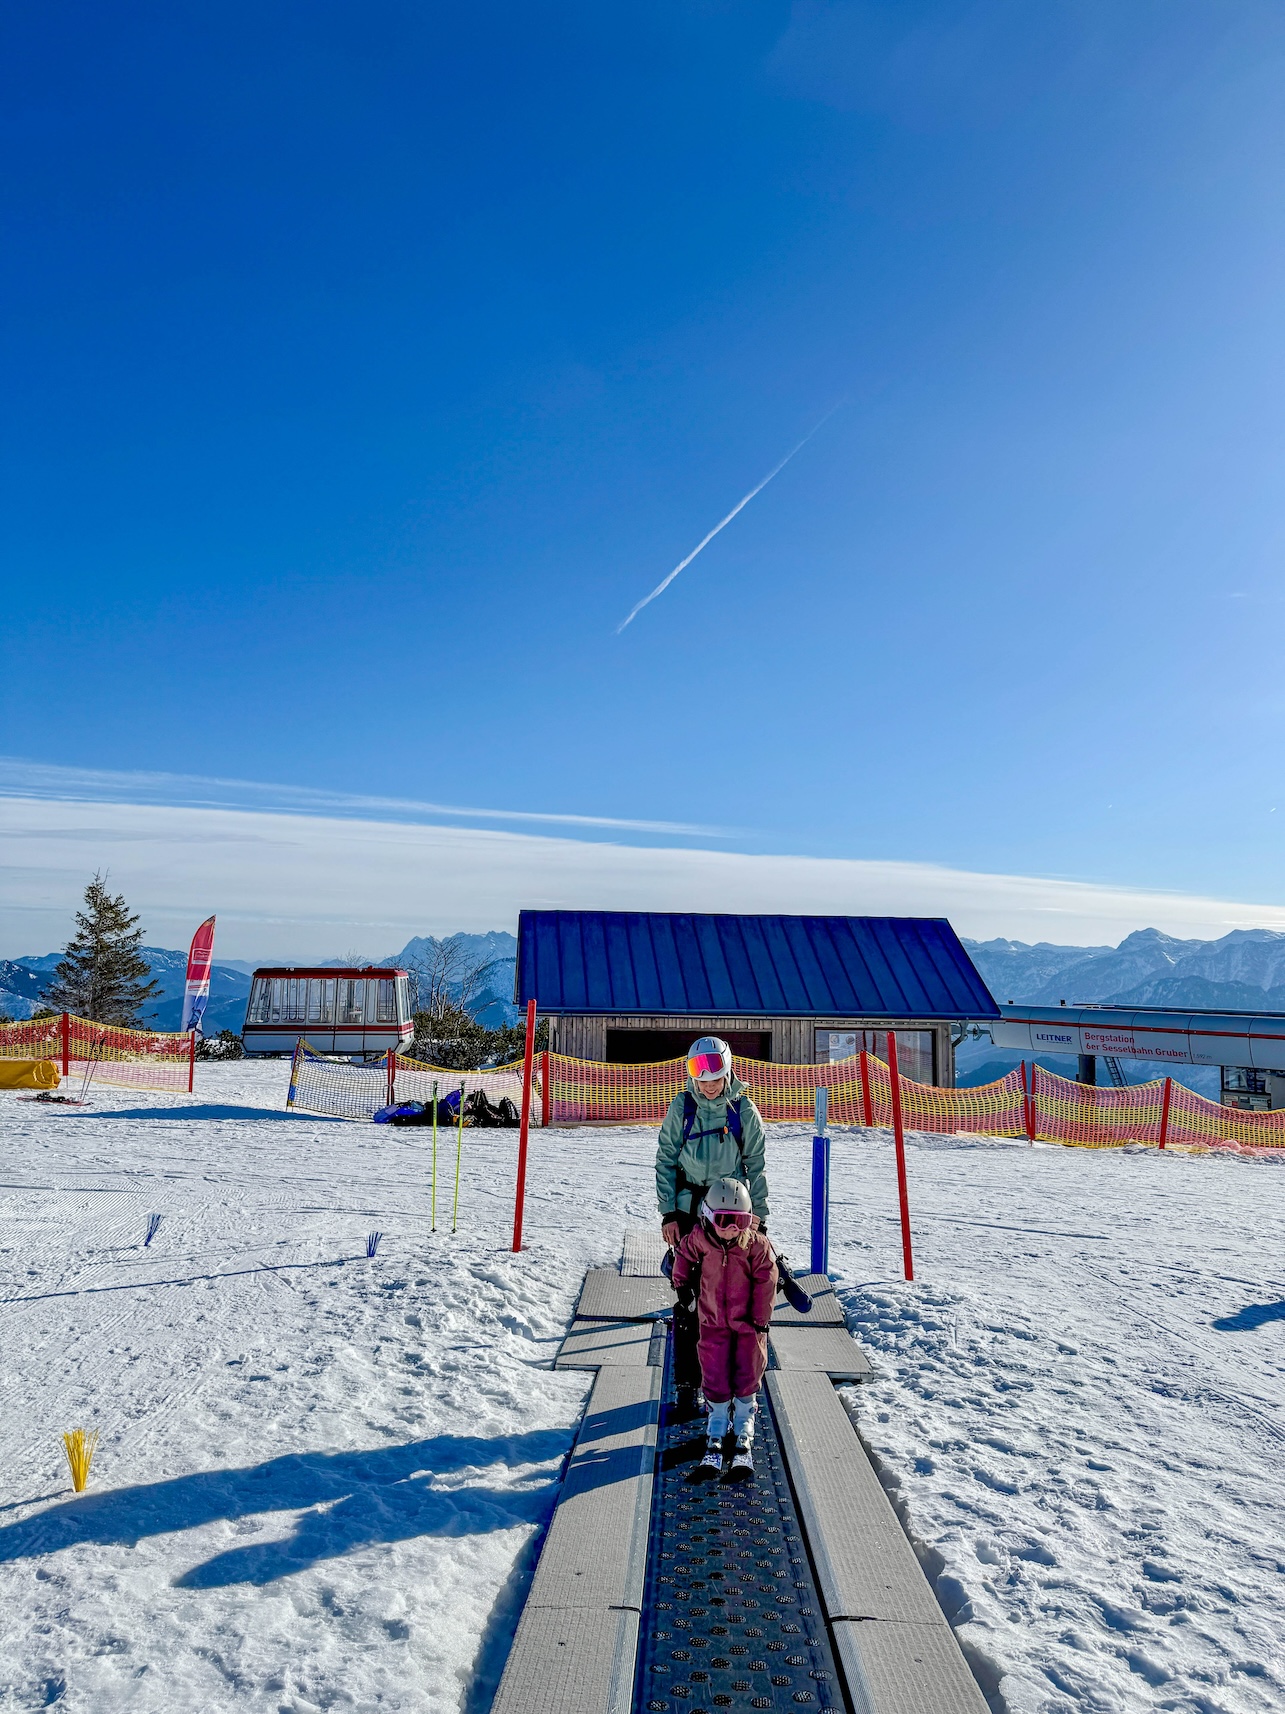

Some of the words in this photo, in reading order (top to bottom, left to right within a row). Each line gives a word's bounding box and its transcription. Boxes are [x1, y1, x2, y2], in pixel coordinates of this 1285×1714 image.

[1036, 1033, 1072, 1042] LEITNER
[1084, 1032, 1135, 1044] Bergstation
[1086, 1043, 1100, 1051] 6er
[1102, 1043, 1153, 1055] Sesselbahn
[1155, 1047, 1188, 1058] Gruber
